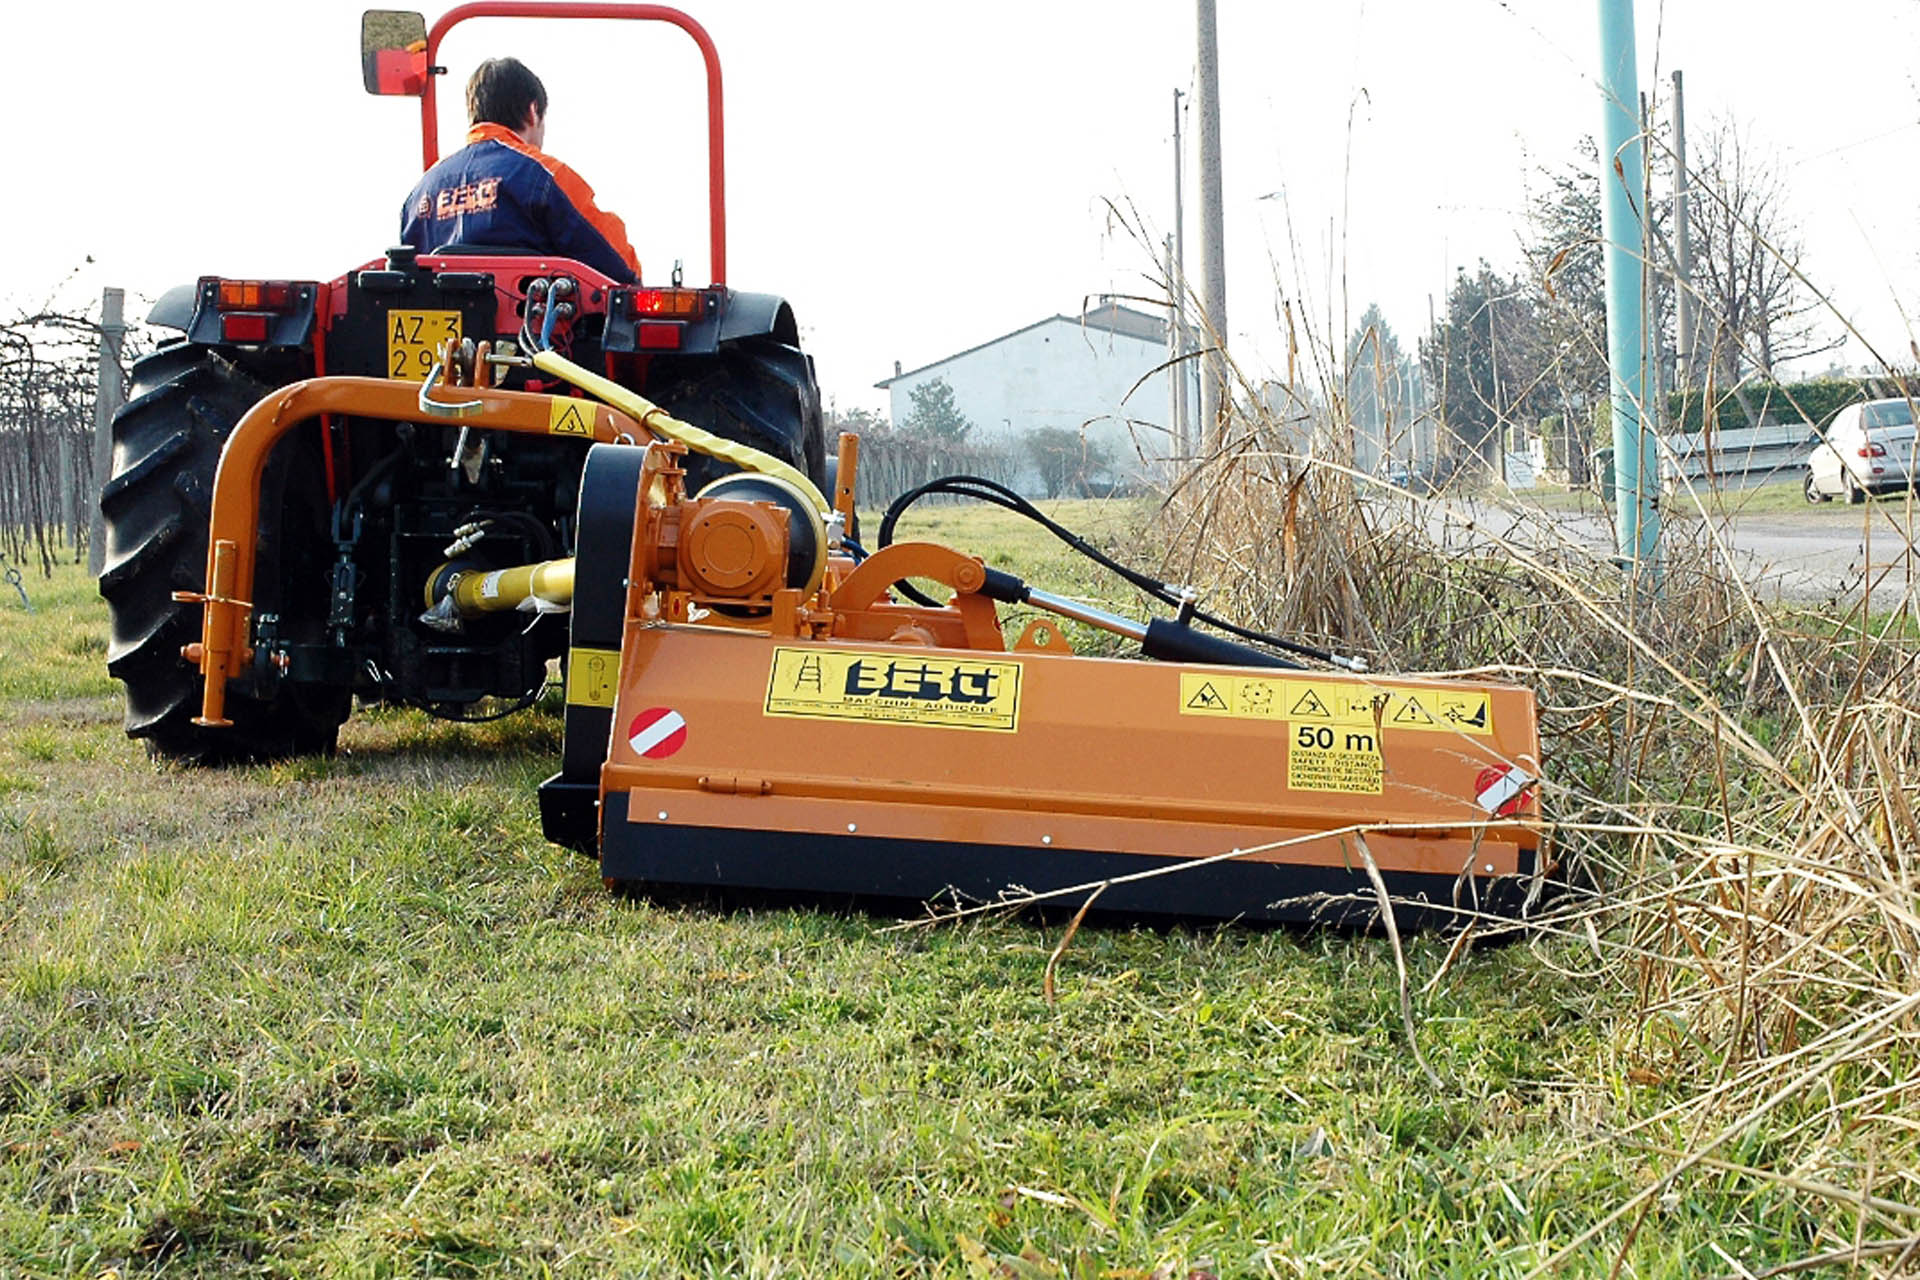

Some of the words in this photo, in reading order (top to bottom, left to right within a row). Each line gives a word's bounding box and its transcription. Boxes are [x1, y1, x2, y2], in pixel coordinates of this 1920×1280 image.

[393, 316, 424, 345] AZ
[444, 316, 460, 342] 3
[393, 349, 433, 377] 29
[844, 659, 999, 705] BERTI
[843, 696, 918, 708] MACCHINE
[924, 701, 997, 713] AGRICOLE
[1241, 705, 1274, 714] STOP
[1297, 726, 1334, 750] 50
[1345, 733, 1373, 752] m
[1291, 750, 1327, 759] DISTANZA
[1291, 757, 1325, 765] SAFETY
[1334, 759, 1379, 769] DISTANCE
